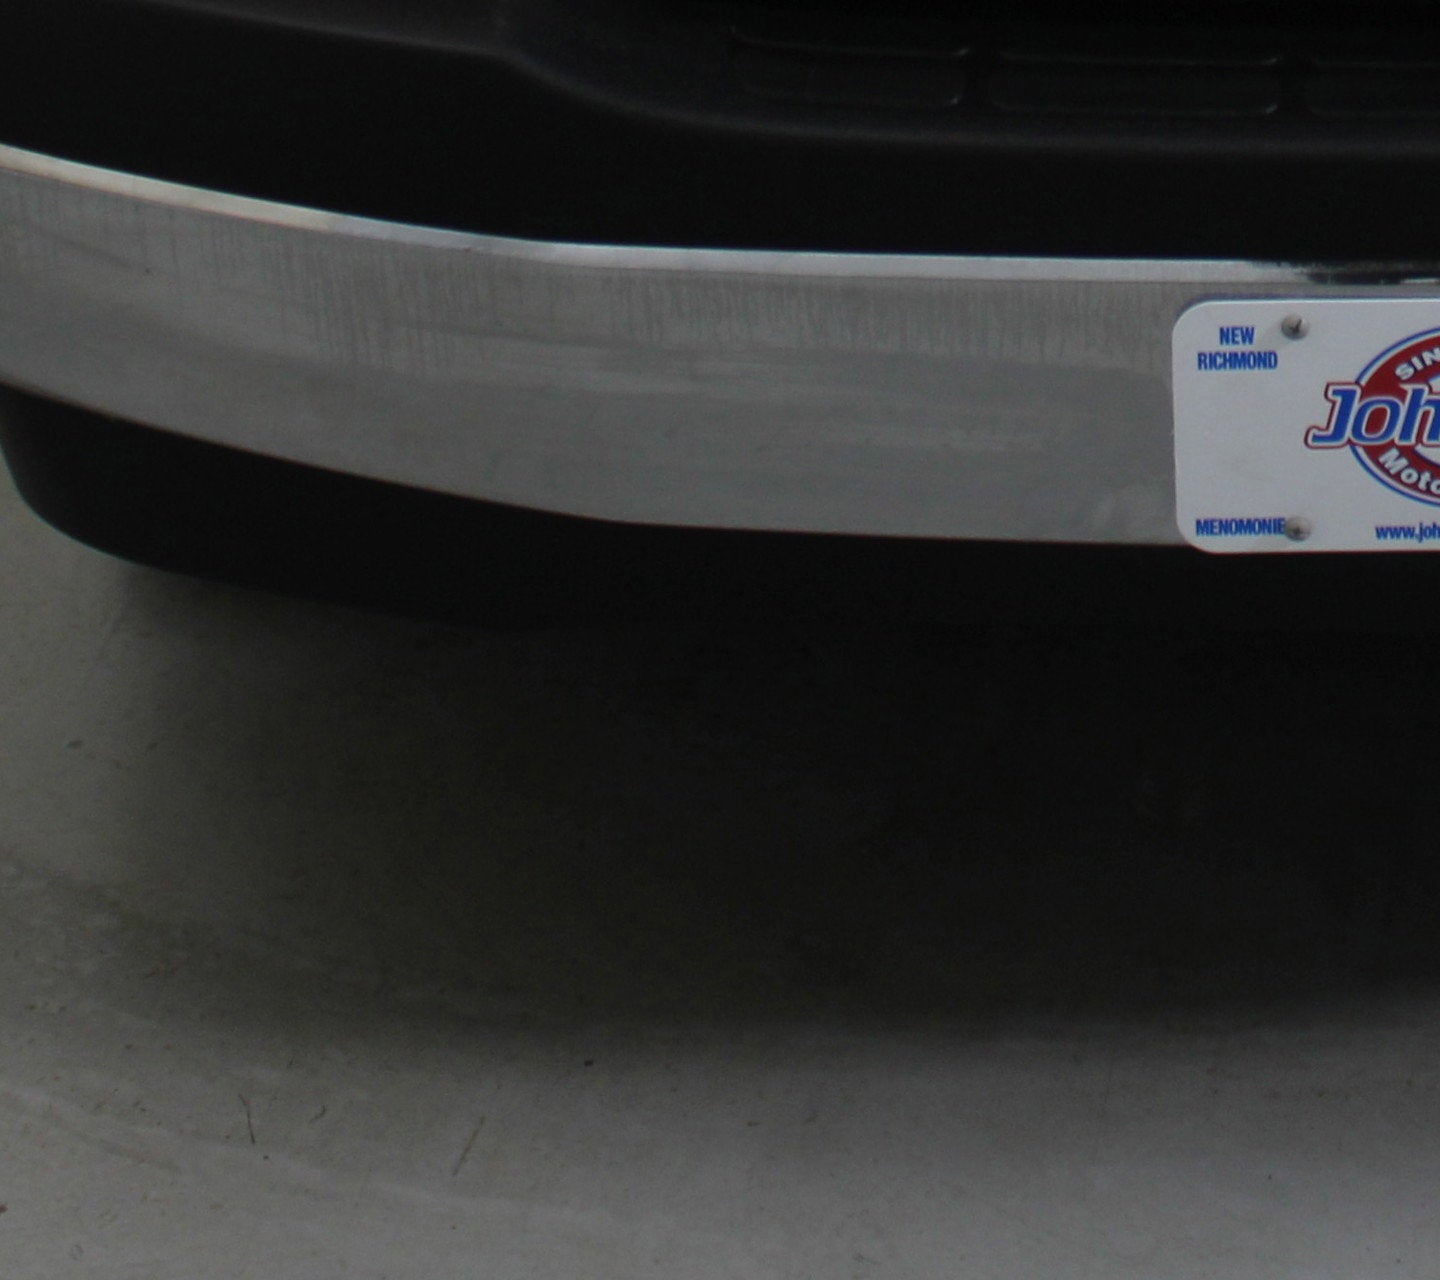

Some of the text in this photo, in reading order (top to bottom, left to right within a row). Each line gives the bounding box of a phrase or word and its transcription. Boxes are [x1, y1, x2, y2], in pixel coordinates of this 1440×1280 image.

[1219, 326, 1255, 346] NEW
[1197, 351, 1278, 371] RICHMOND
[1195, 517, 1286, 537] MENOMONIE
